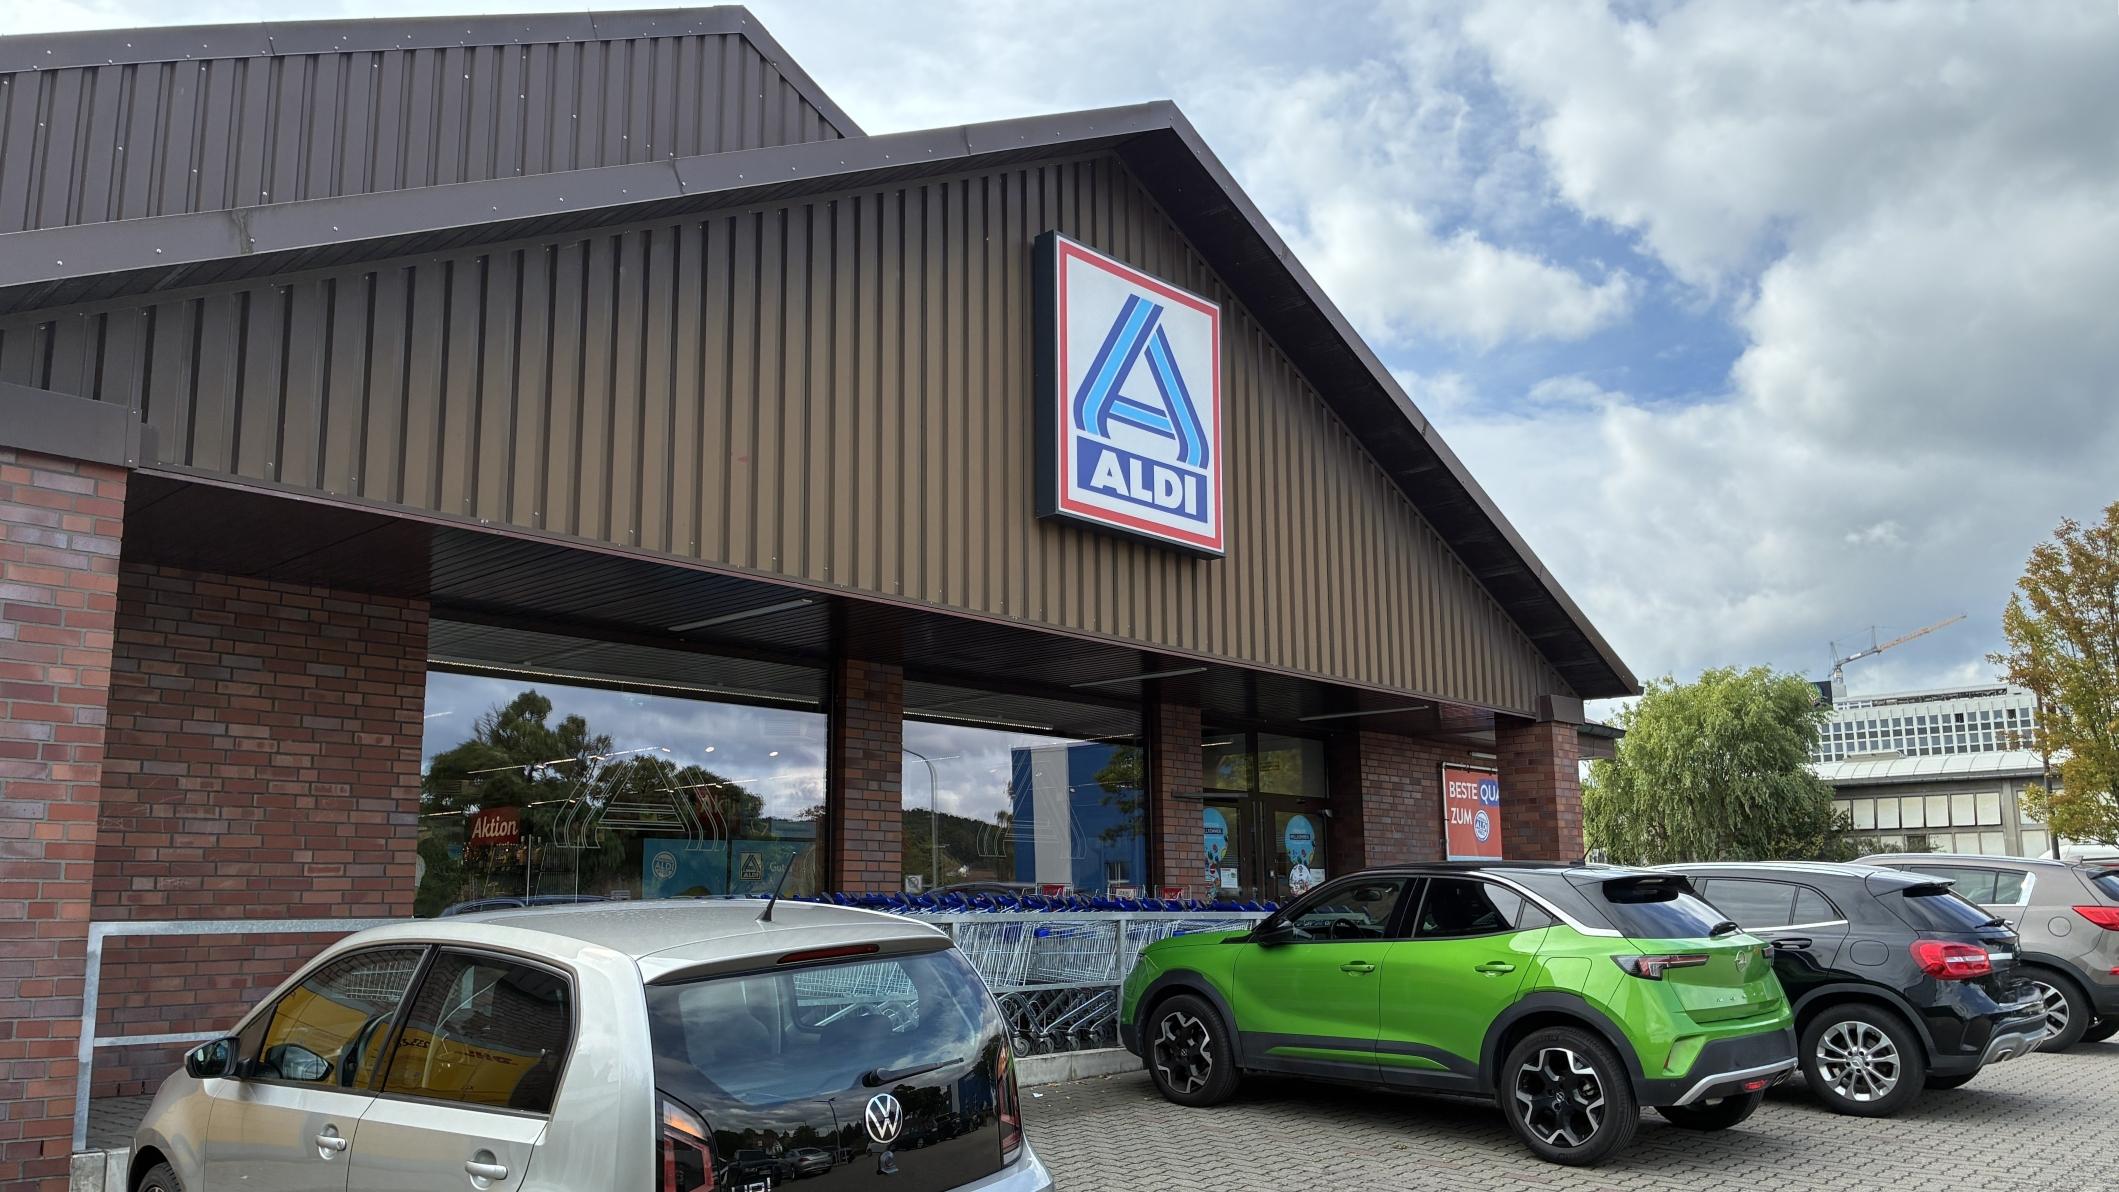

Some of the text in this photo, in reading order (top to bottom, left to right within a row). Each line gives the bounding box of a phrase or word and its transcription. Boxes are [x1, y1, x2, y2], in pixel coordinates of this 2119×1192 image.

[1090, 449, 1197, 516] ALDI
[1449, 781, 1478, 799] BESTE
[1451, 807, 1473, 825] ZUM
[472, 816, 518, 839] Aktion
[743, 871, 760, 879] ALDI
[867, 1094, 901, 1141] VW
